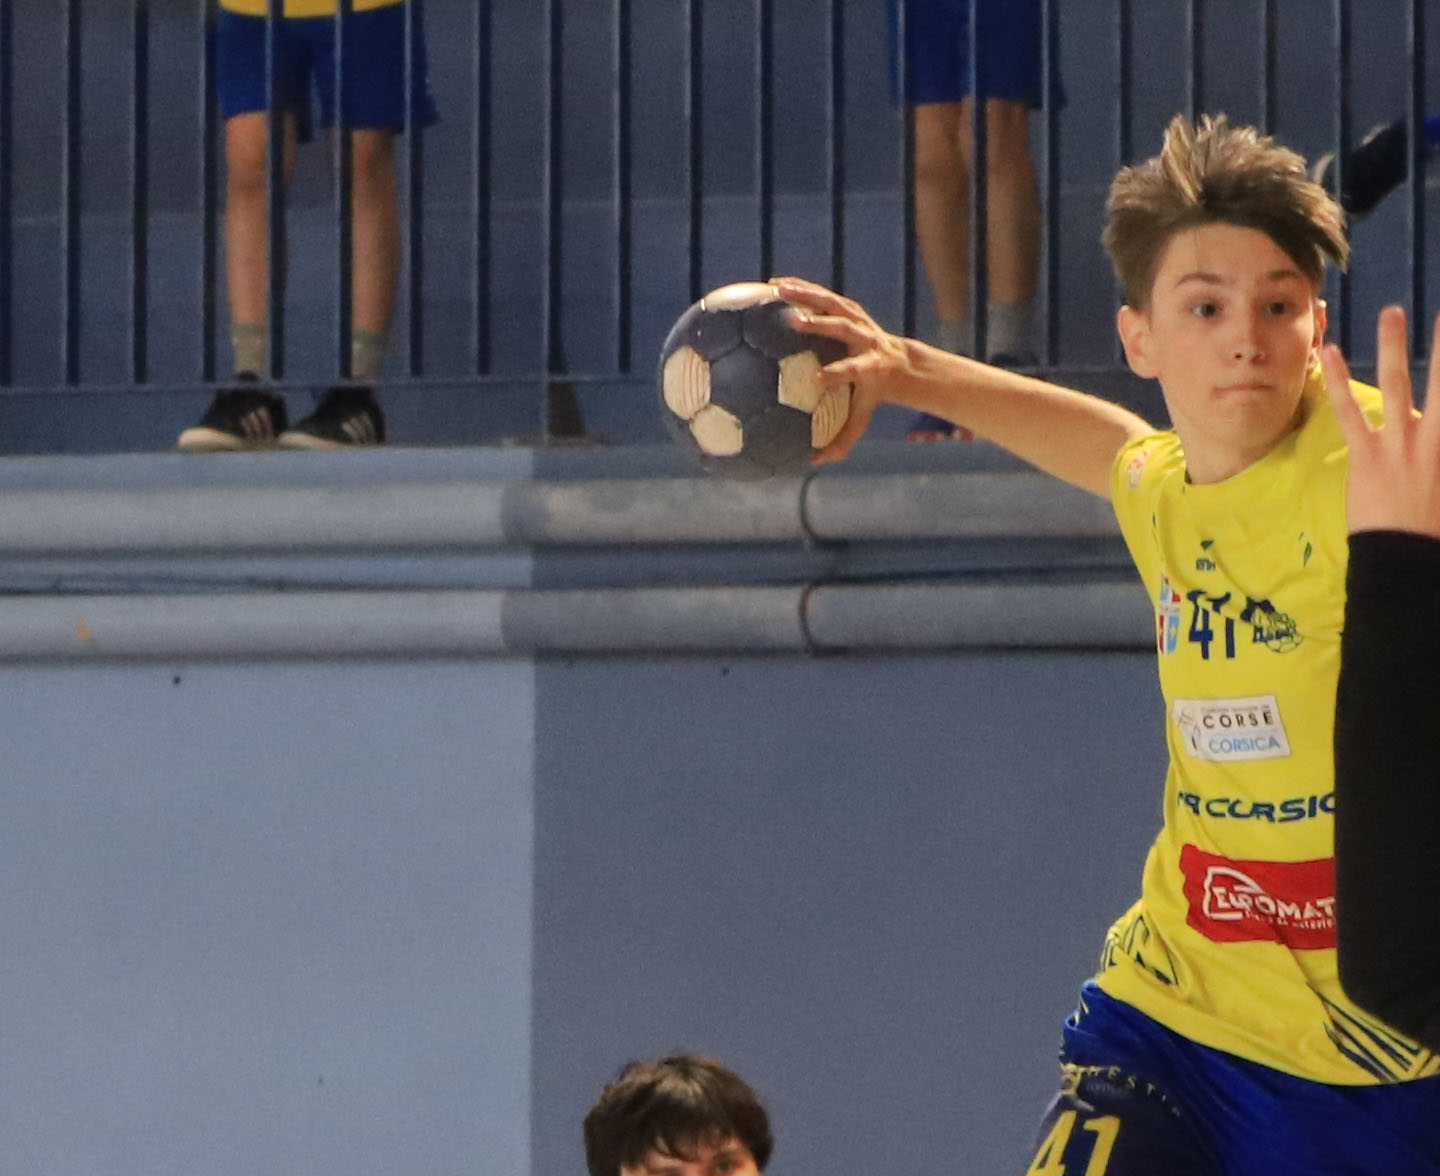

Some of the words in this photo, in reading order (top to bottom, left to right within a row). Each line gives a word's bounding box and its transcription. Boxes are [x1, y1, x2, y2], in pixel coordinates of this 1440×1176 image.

[1187, 590, 1235, 660] 41
[1203, 710, 1274, 729] CORSE
[1208, 735, 1281, 754] CORSICA
